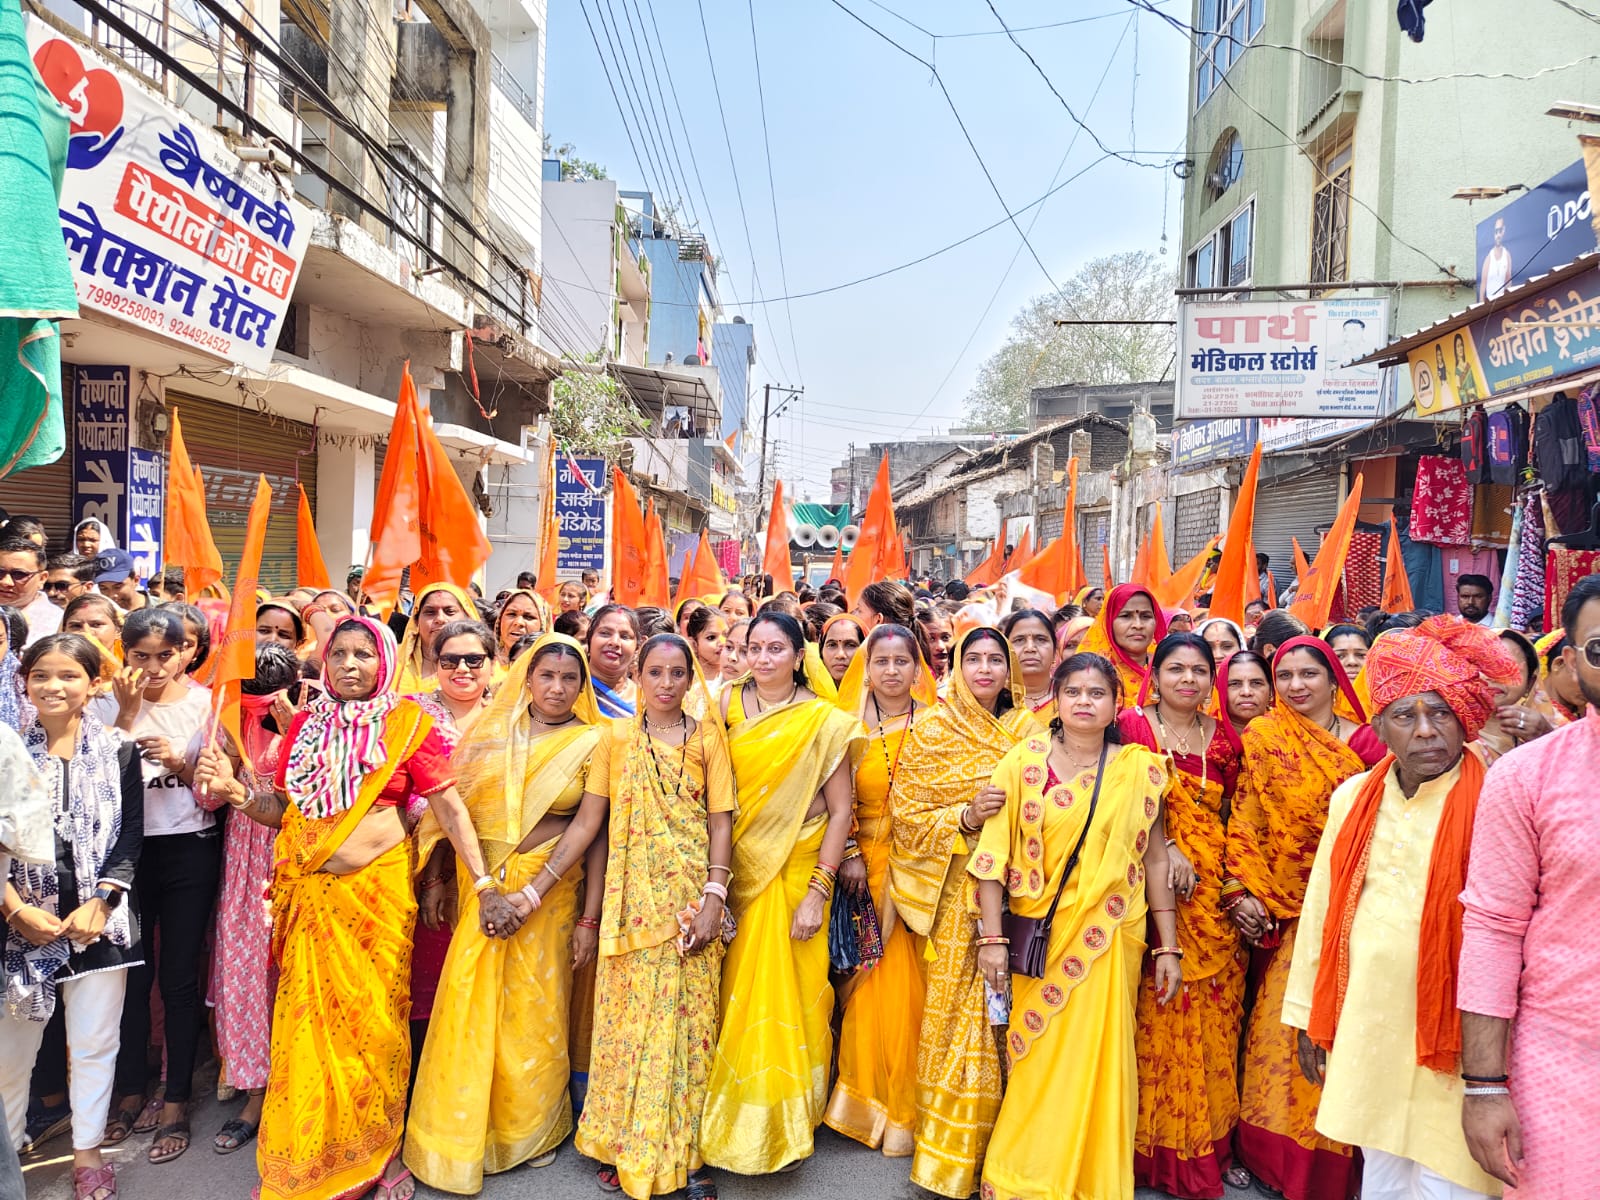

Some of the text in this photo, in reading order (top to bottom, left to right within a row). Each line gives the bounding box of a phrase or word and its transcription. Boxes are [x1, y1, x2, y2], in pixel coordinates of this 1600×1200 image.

[158, 123, 297, 250] वैष्णवी
[254, 249, 291, 295] लैब
[209, 276, 277, 348] सेंटर
[1194, 305, 1318, 344] पार्थ
[169, 318, 232, 354] 9244924522
[1191, 345, 1318, 372] मेडिकल स्टोर्स
[79, 369, 127, 409] वैष्णवी
[132, 451, 160, 485] वैष्णवी
